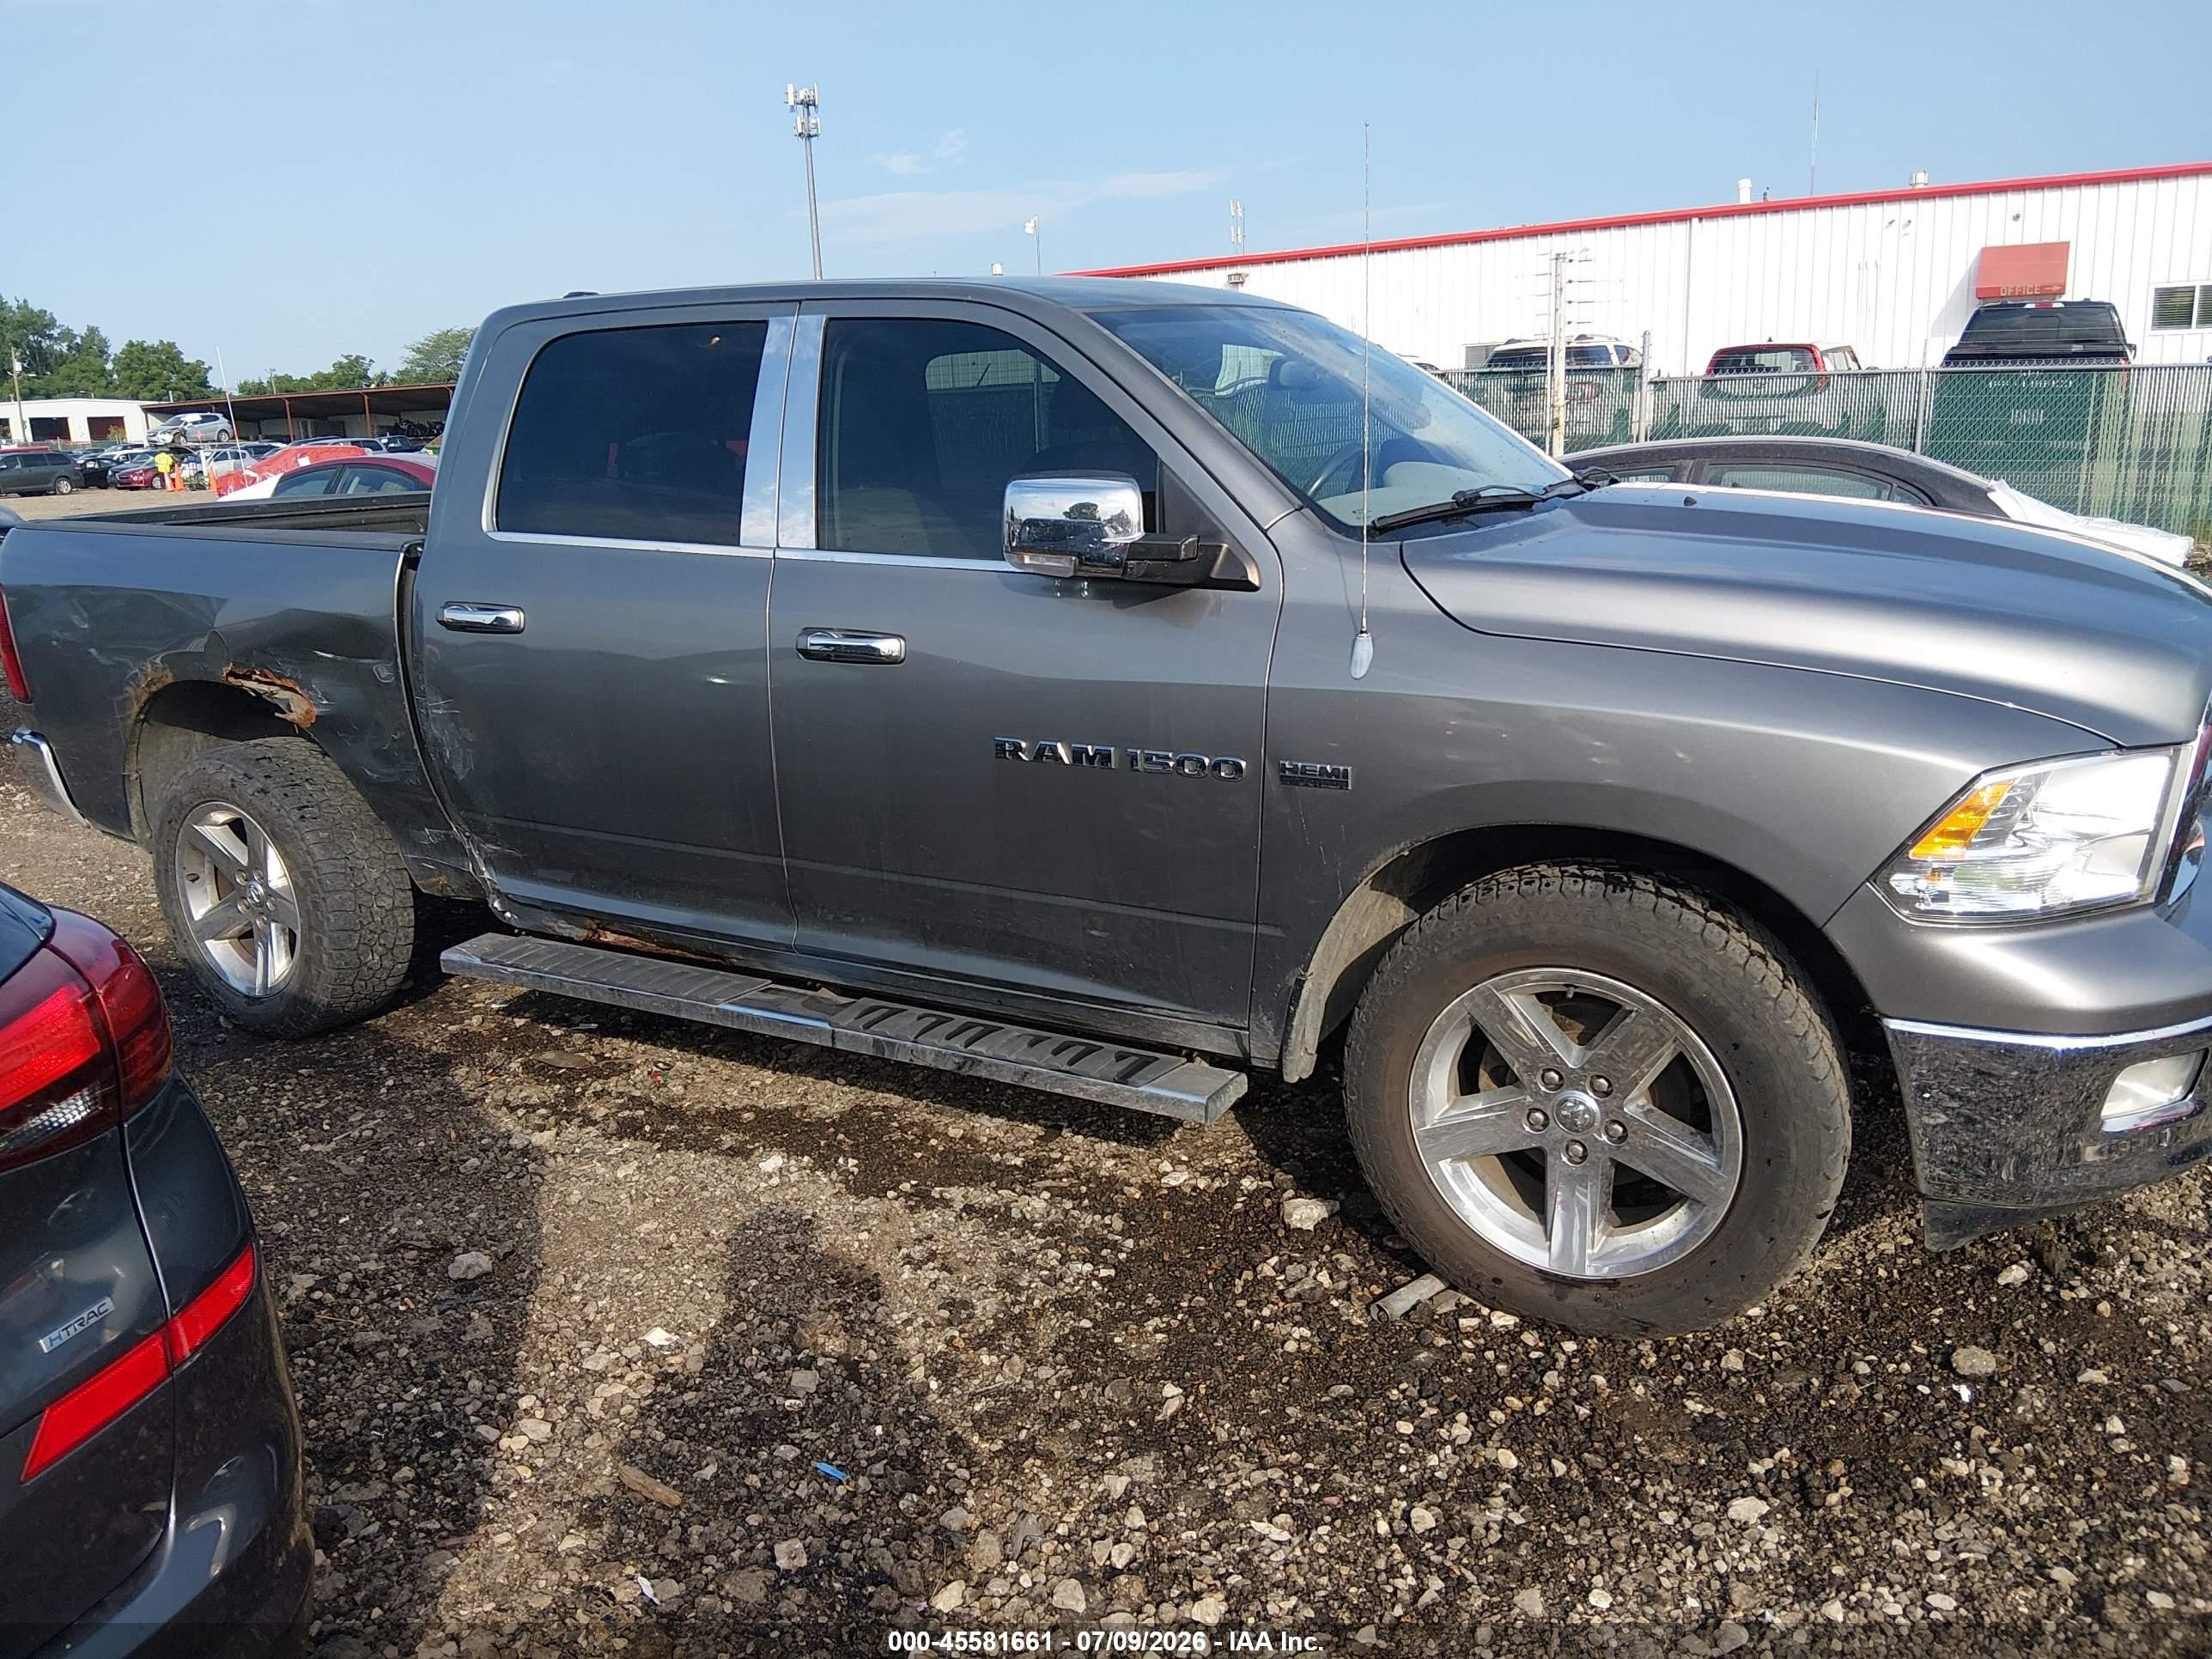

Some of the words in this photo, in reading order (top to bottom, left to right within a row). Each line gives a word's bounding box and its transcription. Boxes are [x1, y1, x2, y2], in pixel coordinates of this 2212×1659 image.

[1999, 284, 2041, 296] OFFICE
[994, 735, 1116, 769] RAM
[1126, 747, 1248, 782] 1500
[1279, 760, 1352, 781] HEMI
[48, 1302, 109, 1347] HTRAC
